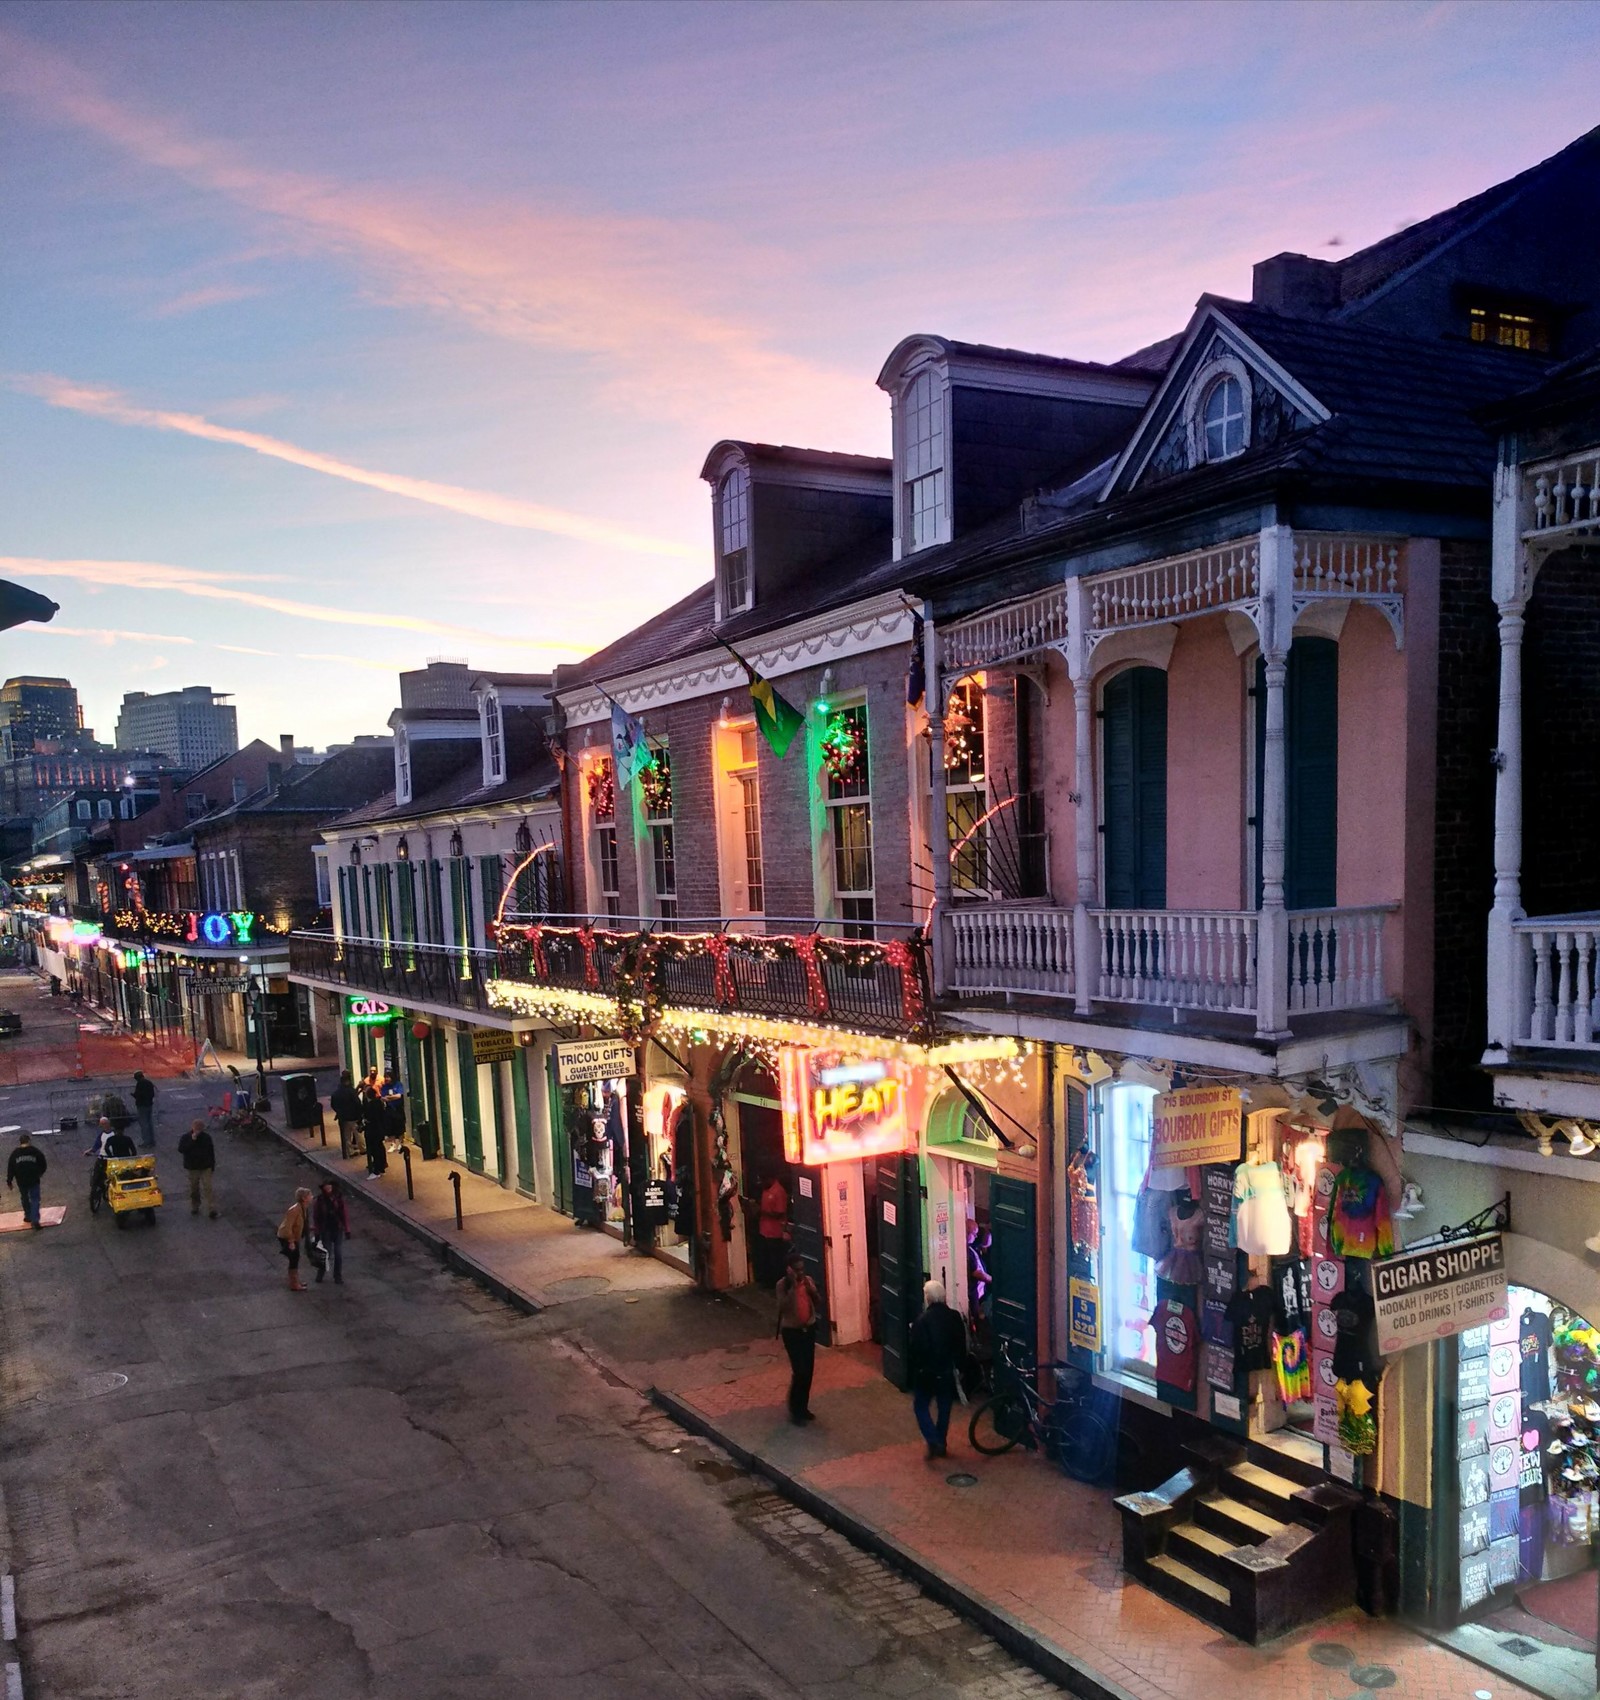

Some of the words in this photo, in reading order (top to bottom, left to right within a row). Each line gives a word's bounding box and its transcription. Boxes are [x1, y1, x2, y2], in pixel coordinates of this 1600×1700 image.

[186, 911, 254, 943] JOY
[351, 1000, 389, 1015] CATS
[475, 1037, 512, 1048] TOBACCO
[584, 1042, 608, 1050] BOURBON
[475, 1051, 514, 1064] CIGARETTES
[560, 1051, 599, 1066] TRICOU
[603, 1047, 632, 1060] GIFTS
[565, 1072, 598, 1082] LOWEST
[601, 1067, 630, 1077] PRICES
[570, 1061, 625, 1074] GUARANTEED
[1163, 1096, 1177, 1109] 715
[1179, 1091, 1219, 1106] BOURBON
[1222, 1089, 1232, 1101] ST
[814, 1078, 899, 1137] HEAT
[1154, 1112, 1206, 1145] BOURBON
[1209, 1107, 1239, 1138] GIFTS
[1207, 1174, 1233, 1190] HORNY
[1379, 1261, 1432, 1294] CIGAR
[1436, 1242, 1500, 1279] SHOPPE
[1380, 1297, 1416, 1316] HOOKAH
[1424, 1289, 1449, 1305] PIPES
[1456, 1273, 1505, 1296] CIGARETTES
[1080, 1300, 1088, 1313] 5
[1393, 1314, 1416, 1330] COLD
[1420, 1304, 1451, 1322] DRINKS
[1458, 1291, 1495, 1311] T-SHIRTS
[1074, 1320, 1095, 1336] $20
[1466, 1562, 1487, 1576] JESUS
[1466, 1571, 1487, 1584] LOVES
